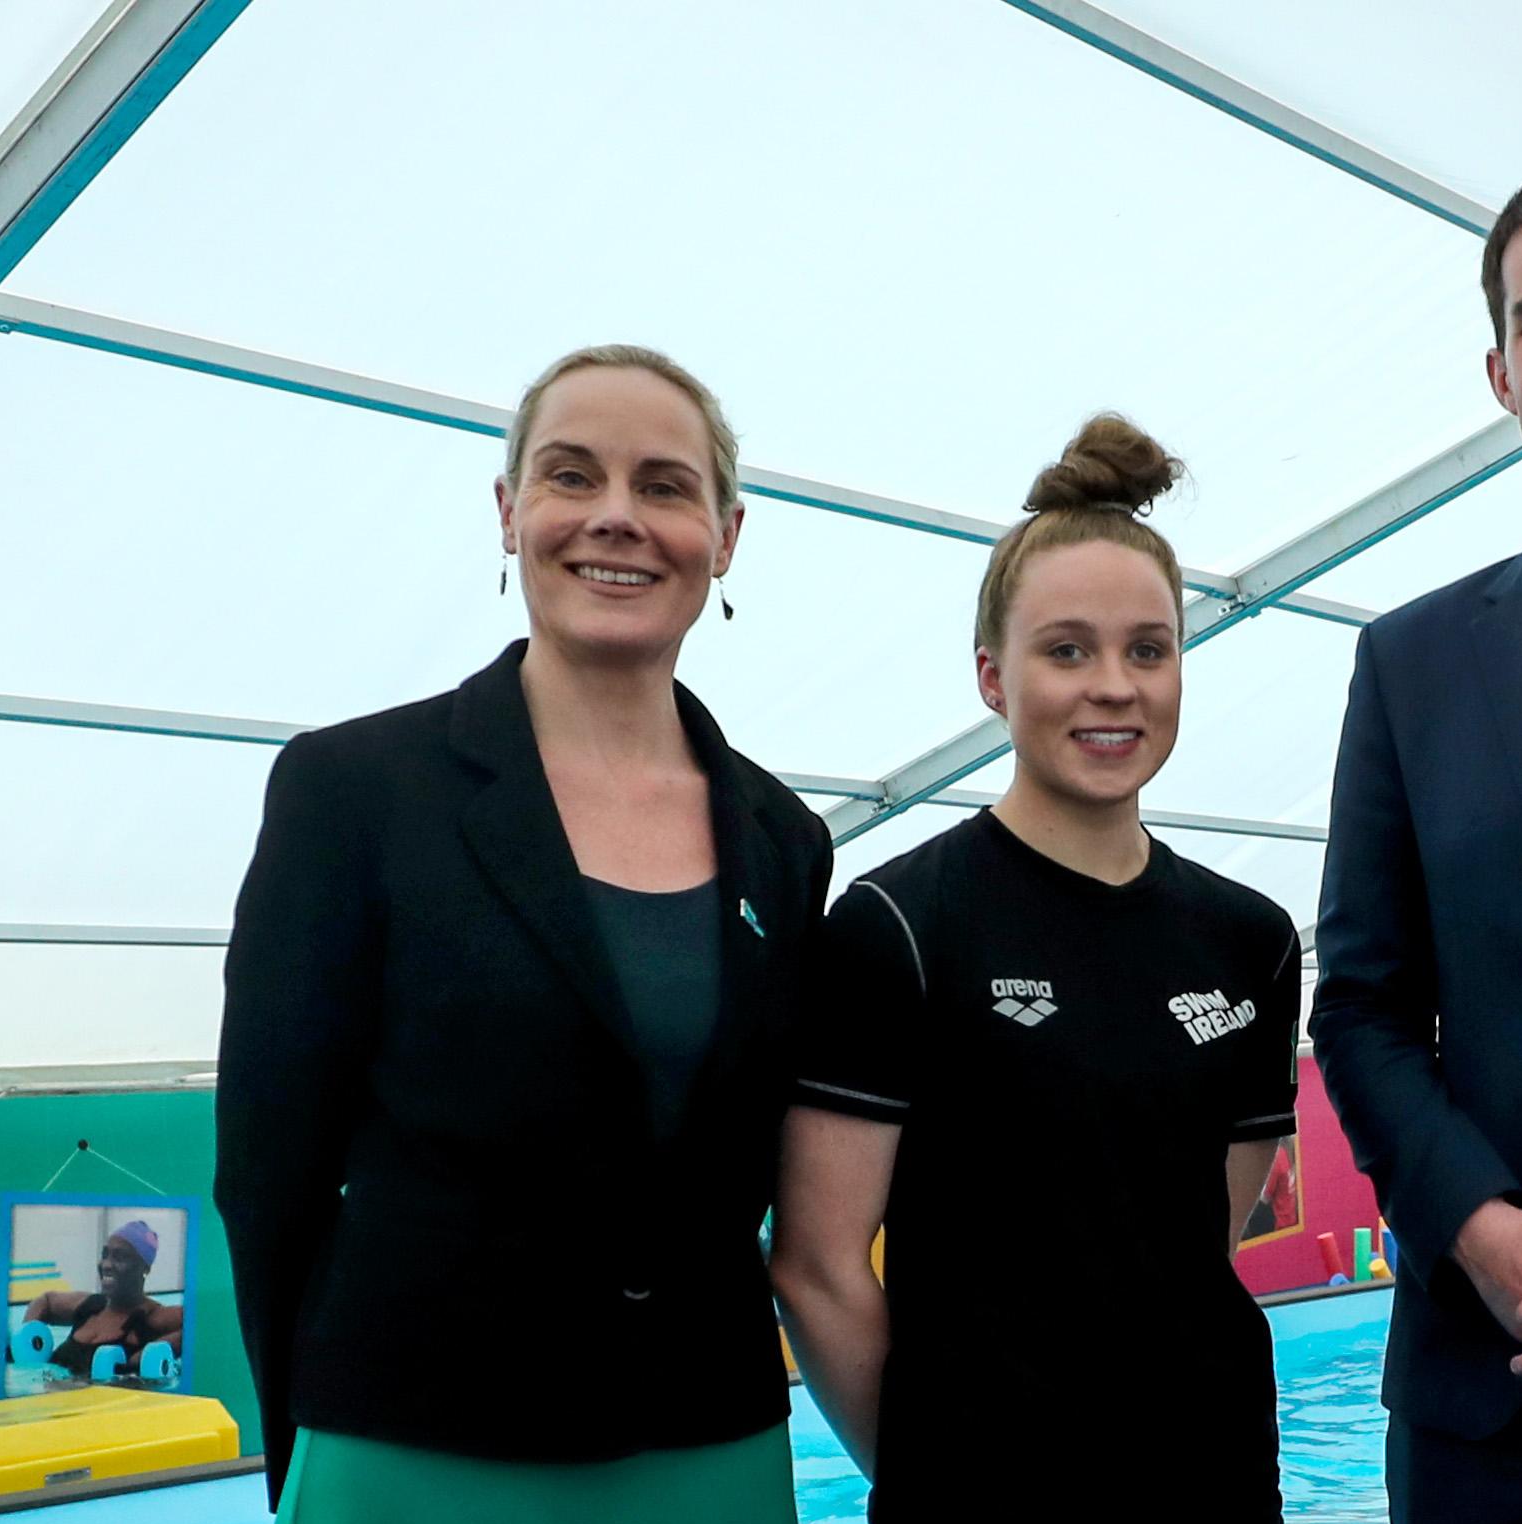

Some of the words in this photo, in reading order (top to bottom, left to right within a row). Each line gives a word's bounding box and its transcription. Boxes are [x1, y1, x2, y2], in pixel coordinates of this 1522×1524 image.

[990, 978, 1054, 998] arena
[1168, 988, 1231, 1022] SWIM
[1183, 999, 1257, 1046] IRELAND
